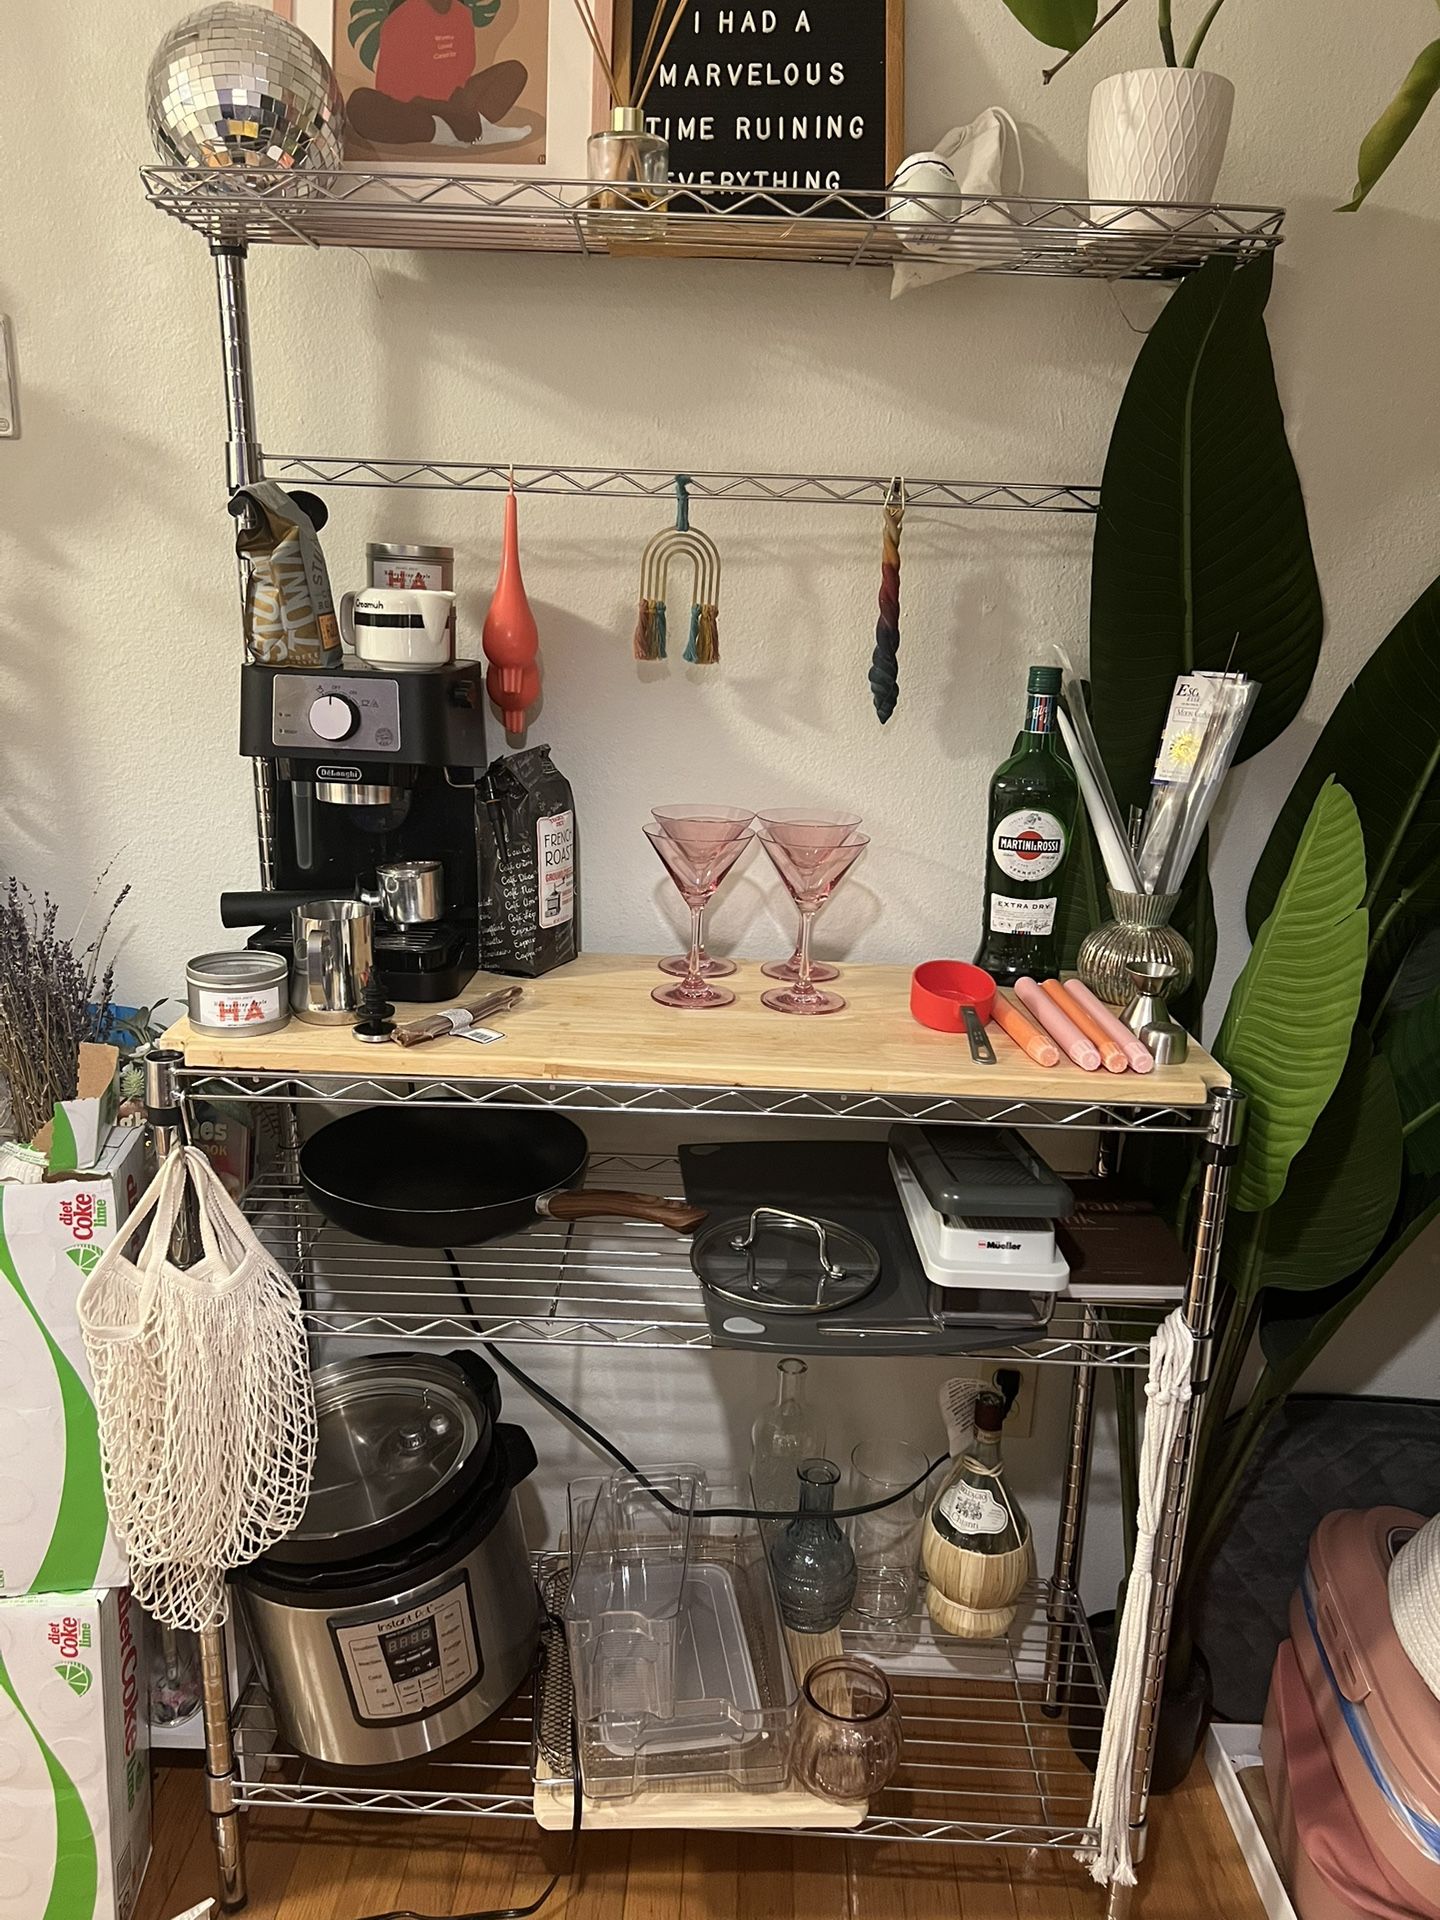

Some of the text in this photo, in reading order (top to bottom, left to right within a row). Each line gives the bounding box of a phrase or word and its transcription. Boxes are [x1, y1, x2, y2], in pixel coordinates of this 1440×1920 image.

[694, 9, 811, 34] I HAD A
[660, 62, 845, 88] MARVELOUS
[645, 115, 864, 141] TIME RUINING
[997, 900, 1029, 909] EXTRA
[59, 1200, 73, 1226] diet
[73, 1193, 93, 1240] Coke
[93, 1199, 107, 1227] lime
[48, 1622, 60, 1645] diet
[60, 1617, 78, 1658] Coke
[79, 1623, 91, 1648] lime
